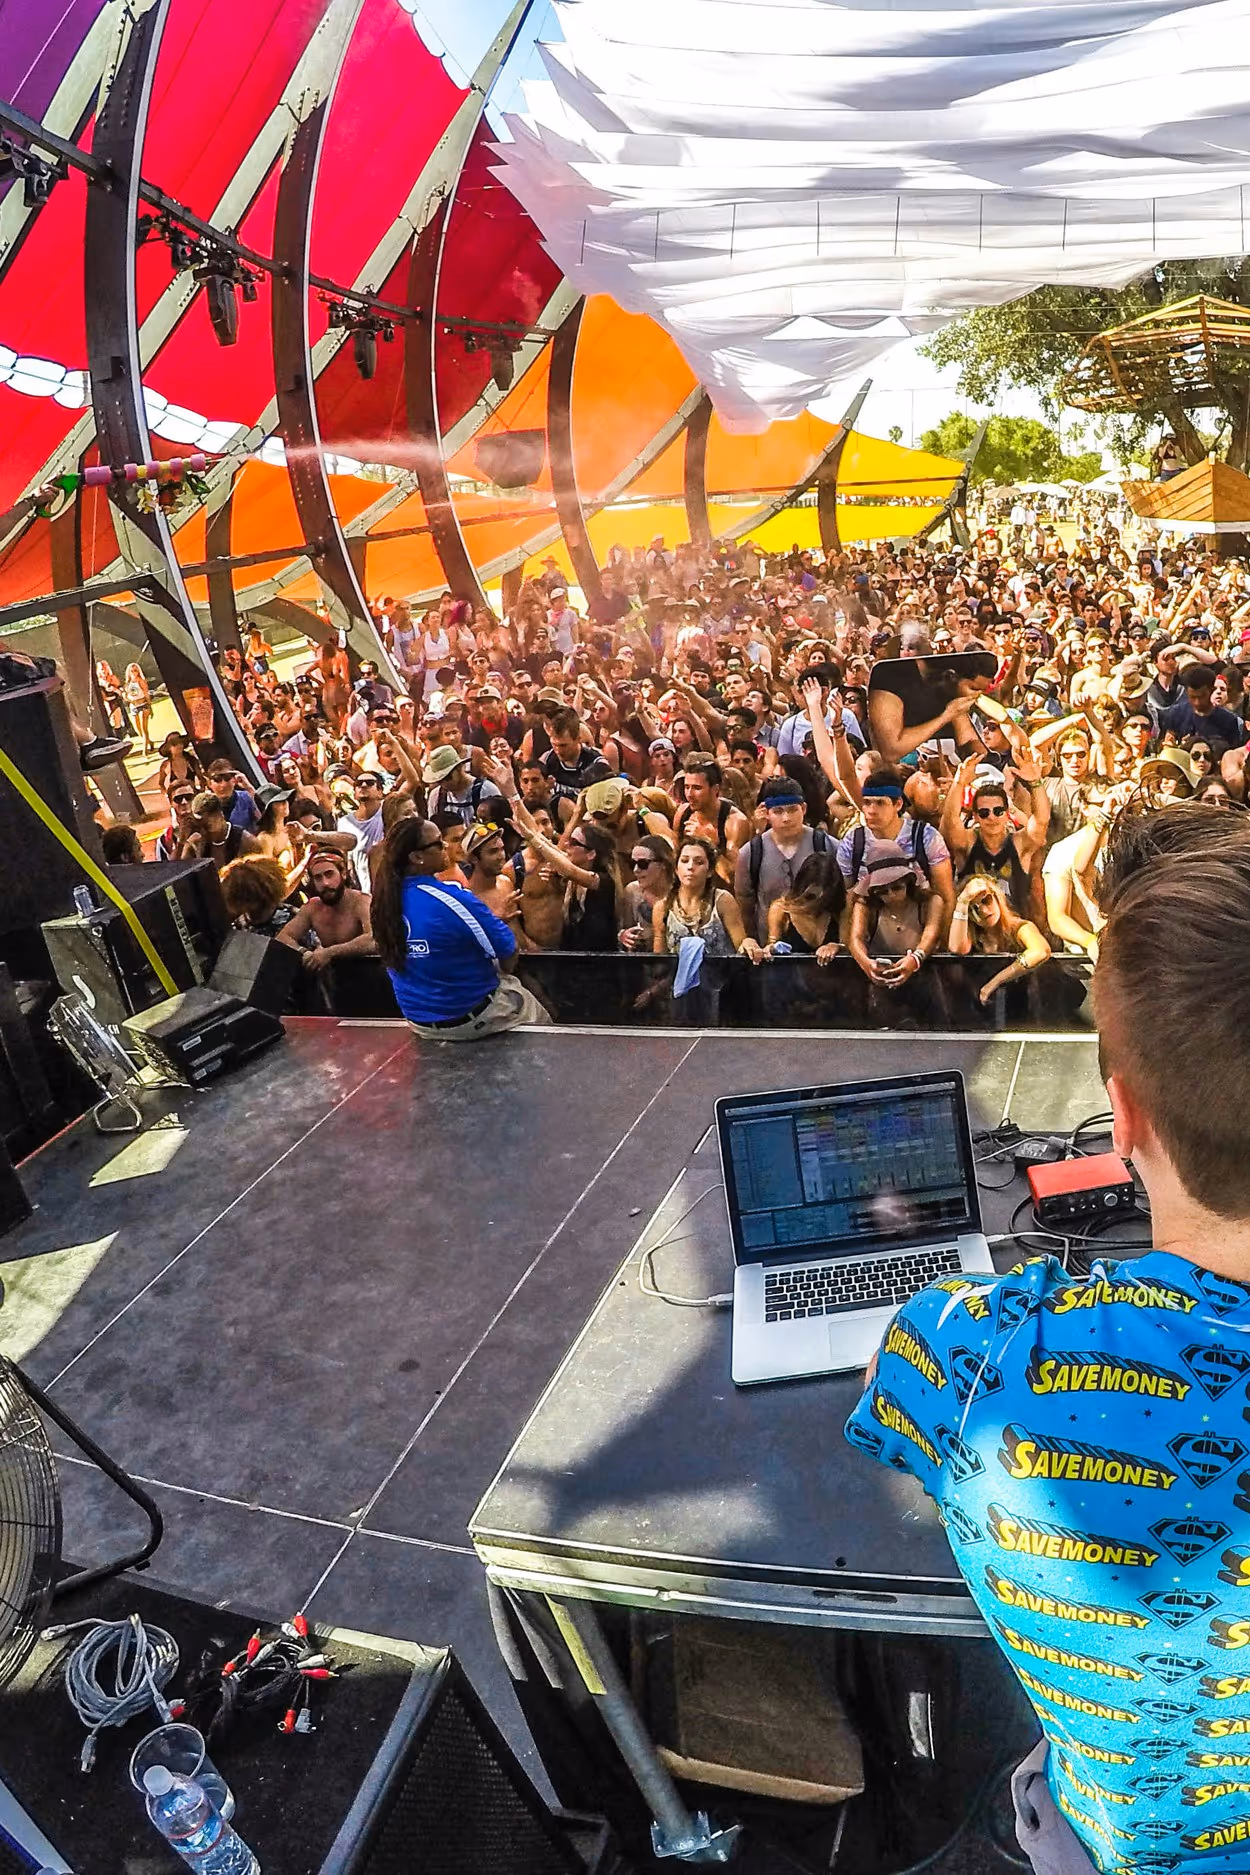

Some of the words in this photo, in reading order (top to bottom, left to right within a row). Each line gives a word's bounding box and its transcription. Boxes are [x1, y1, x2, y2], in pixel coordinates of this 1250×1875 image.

[883, 1324, 947, 1391] SAVEMONEY
[1032, 1359, 1191, 1402] SAVEMONEY
[1007, 1440, 1179, 1490] SAVEMONEY
[999, 1519, 1159, 1567] SAVEMONEY
[997, 1579, 1150, 1630] SAVEMONEY
[1004, 1628, 1146, 1682] SAVEMONEY
[1018, 1668, 1142, 1724] SAVEMONEY
